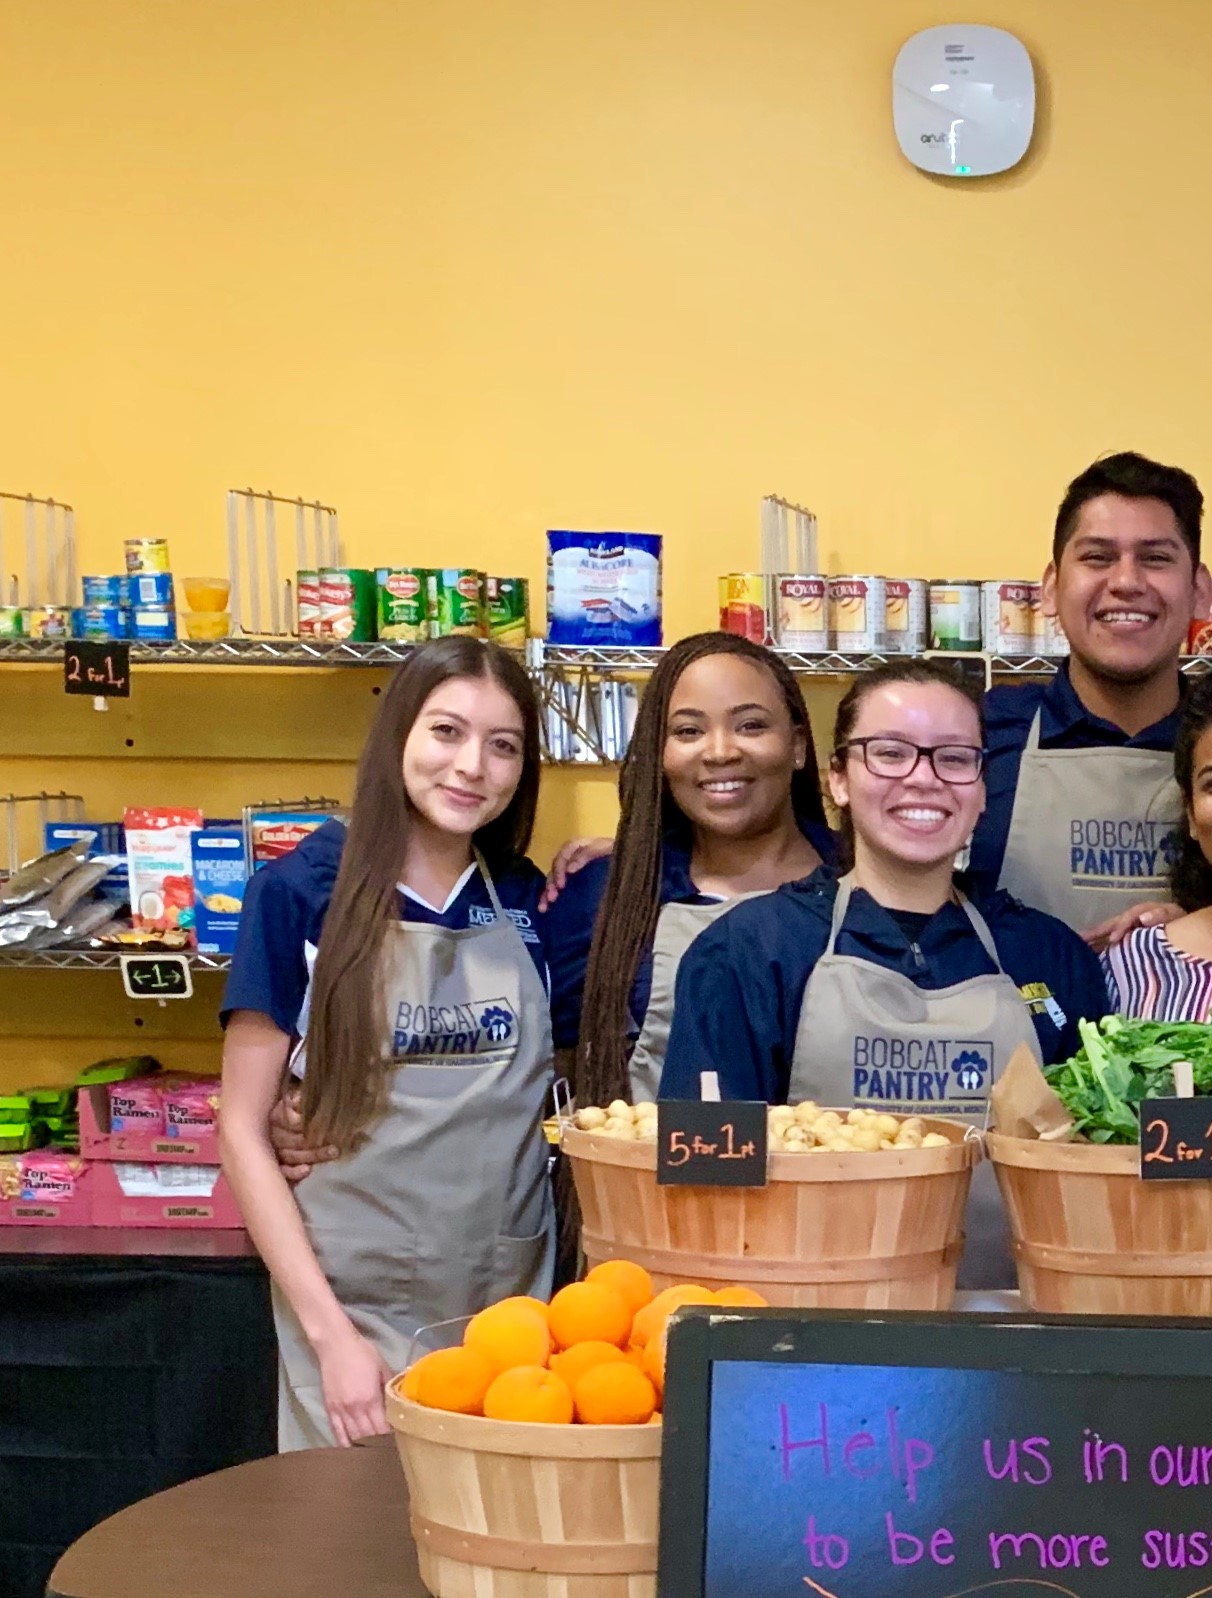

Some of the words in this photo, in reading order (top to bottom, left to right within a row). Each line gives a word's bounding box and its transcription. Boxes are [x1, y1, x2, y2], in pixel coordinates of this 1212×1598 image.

[785, 584, 821, 597] ROYAL
[831, 585, 861, 598] OYAL
[67, 655, 82, 682] 2
[1070, 818, 1158, 850] BOBCAT
[1071, 846, 1159, 877] PANTRY
[151, 964, 168, 987] 1
[396, 1000, 479, 1035] BOBCAT
[392, 1029, 480, 1057] PANTRY
[854, 1035, 951, 1070] BOBCAT
[853, 1067, 950, 1100] PANTRY
[112, 1096, 136, 1108] Top
[113, 1106, 159, 1118] Ramen
[168, 1103, 188, 1116] Top
[168, 1113, 213, 1125] Ramen
[667, 1131, 691, 1166] 5
[691, 1135, 718, 1155] for
[1144, 1119, 1174, 1163] 2
[24, 1168, 48, 1181] Top
[24, 1179, 71, 1191] Ramen
[780, 1401, 935, 1503] Help
[983, 1436, 1053, 1486] us
[1083, 1427, 1128, 1484] in
[803, 1513, 850, 1570] to
[885, 1510, 956, 1566] be
[988, 1530, 1110, 1569] more
